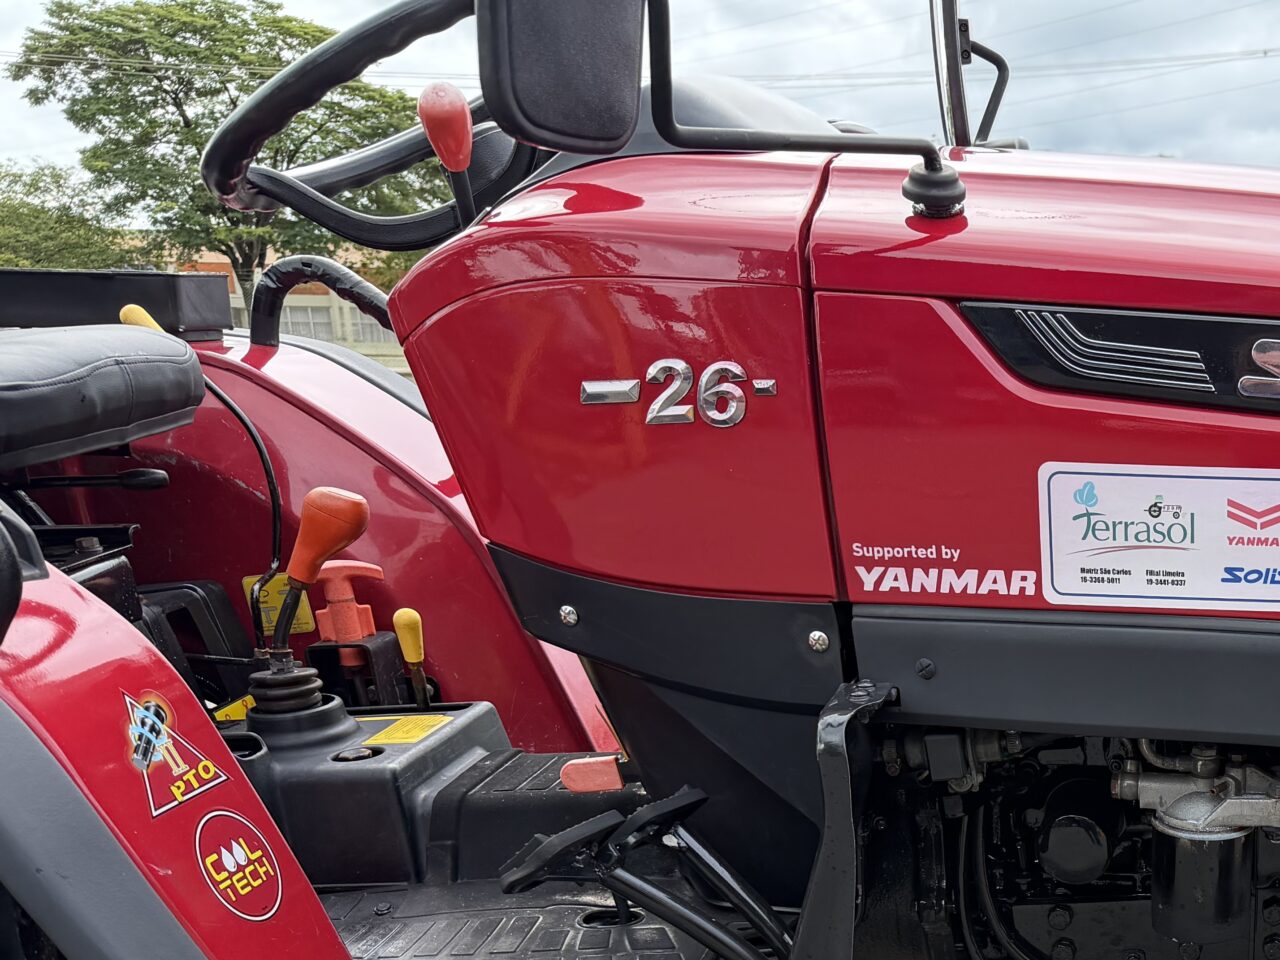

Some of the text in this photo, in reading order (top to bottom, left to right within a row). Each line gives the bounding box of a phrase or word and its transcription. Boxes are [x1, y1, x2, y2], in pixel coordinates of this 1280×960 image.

[1072, 508, 1195, 544] Terrasol
[852, 542, 960, 562] Supported by
[854, 565, 1037, 595] YANMAR
[170, 760, 216, 803] PTO
[218, 857, 274, 902] TECH
